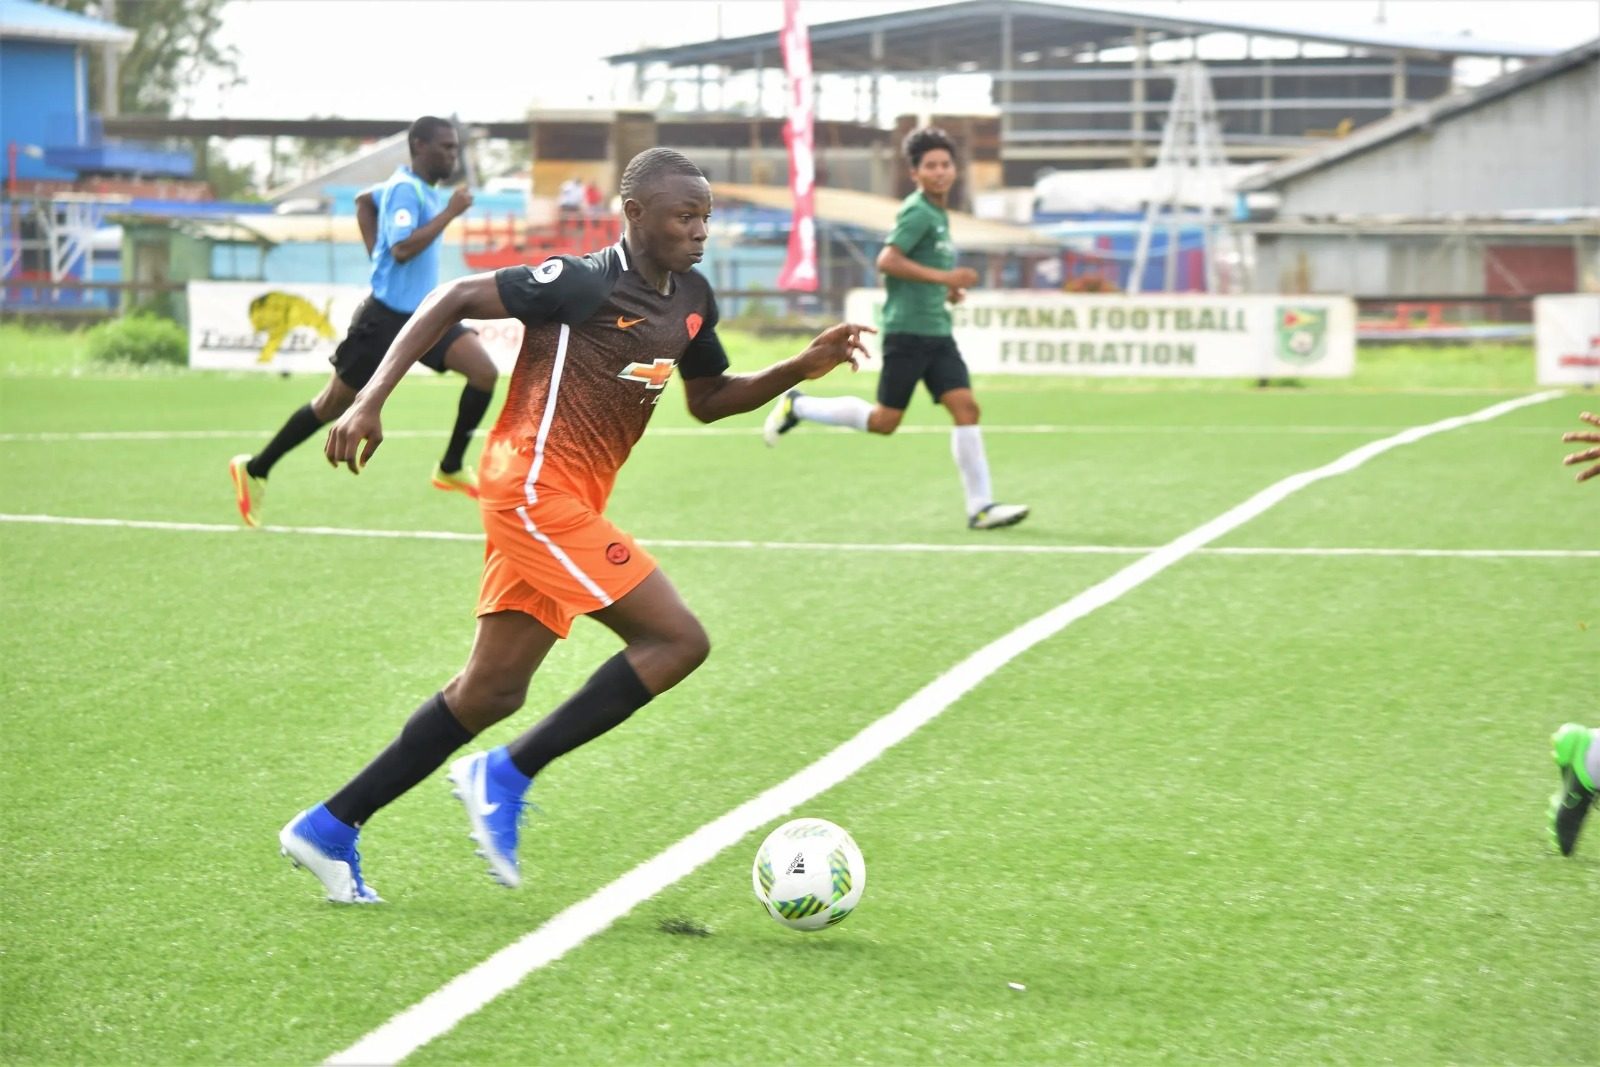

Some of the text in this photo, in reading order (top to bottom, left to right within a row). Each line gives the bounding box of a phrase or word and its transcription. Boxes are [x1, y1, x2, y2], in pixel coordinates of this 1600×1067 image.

[952, 306, 1248, 332] GUYANA FOOTBALL
[1000, 340, 1197, 366] FEDERATION
